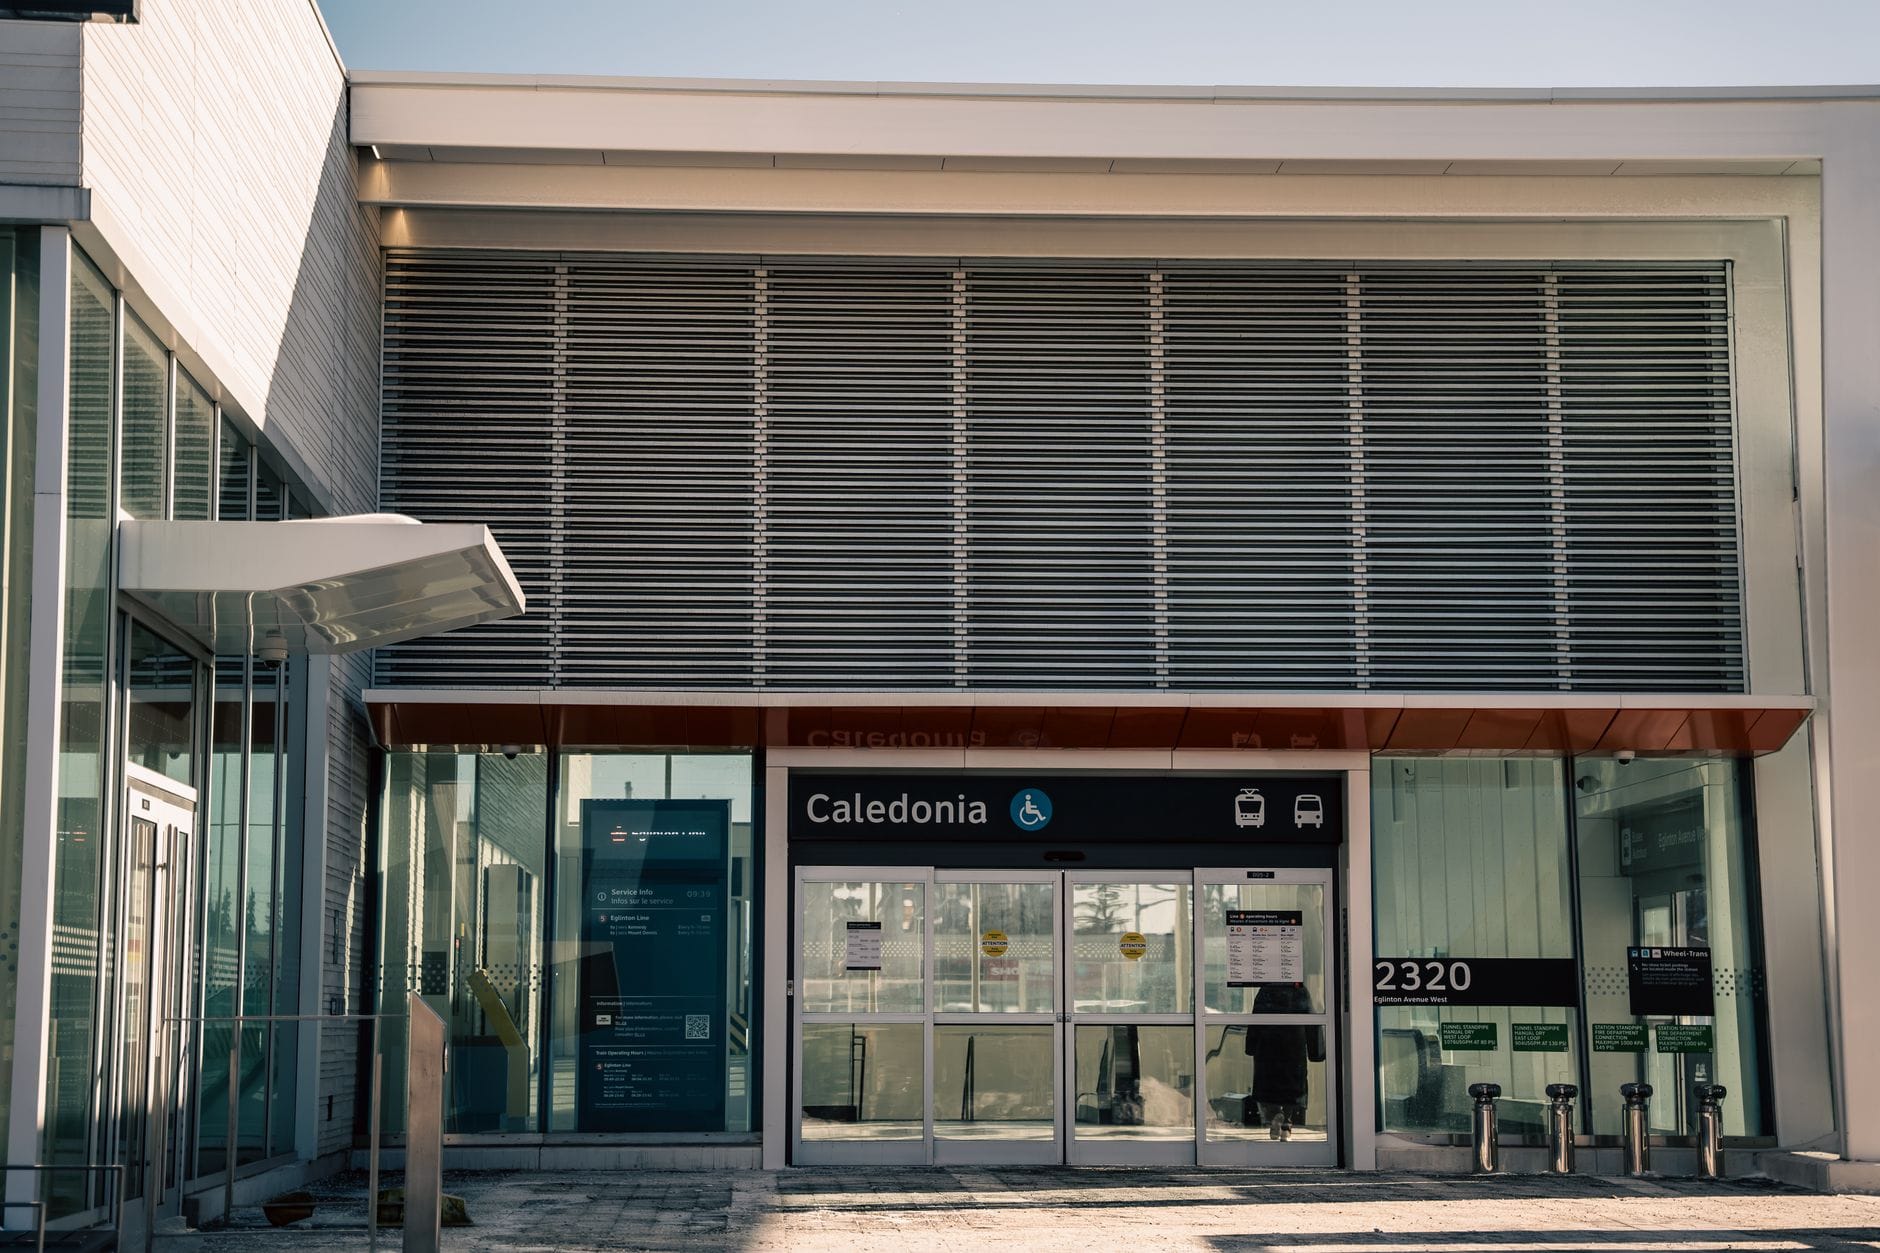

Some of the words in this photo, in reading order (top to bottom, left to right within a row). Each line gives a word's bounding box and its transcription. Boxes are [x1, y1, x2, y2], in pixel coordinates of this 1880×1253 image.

[807, 793, 987, 824] Caledonia
[611, 888, 638, 896] Service
[639, 888, 654, 896] Info
[687, 889, 711, 898] 09:39
[611, 897, 628, 905] Infos
[641, 897, 649, 905] le
[650, 897, 674, 905] service
[1376, 961, 1471, 991] 2320
[1374, 996, 1401, 1004] Eglinton
